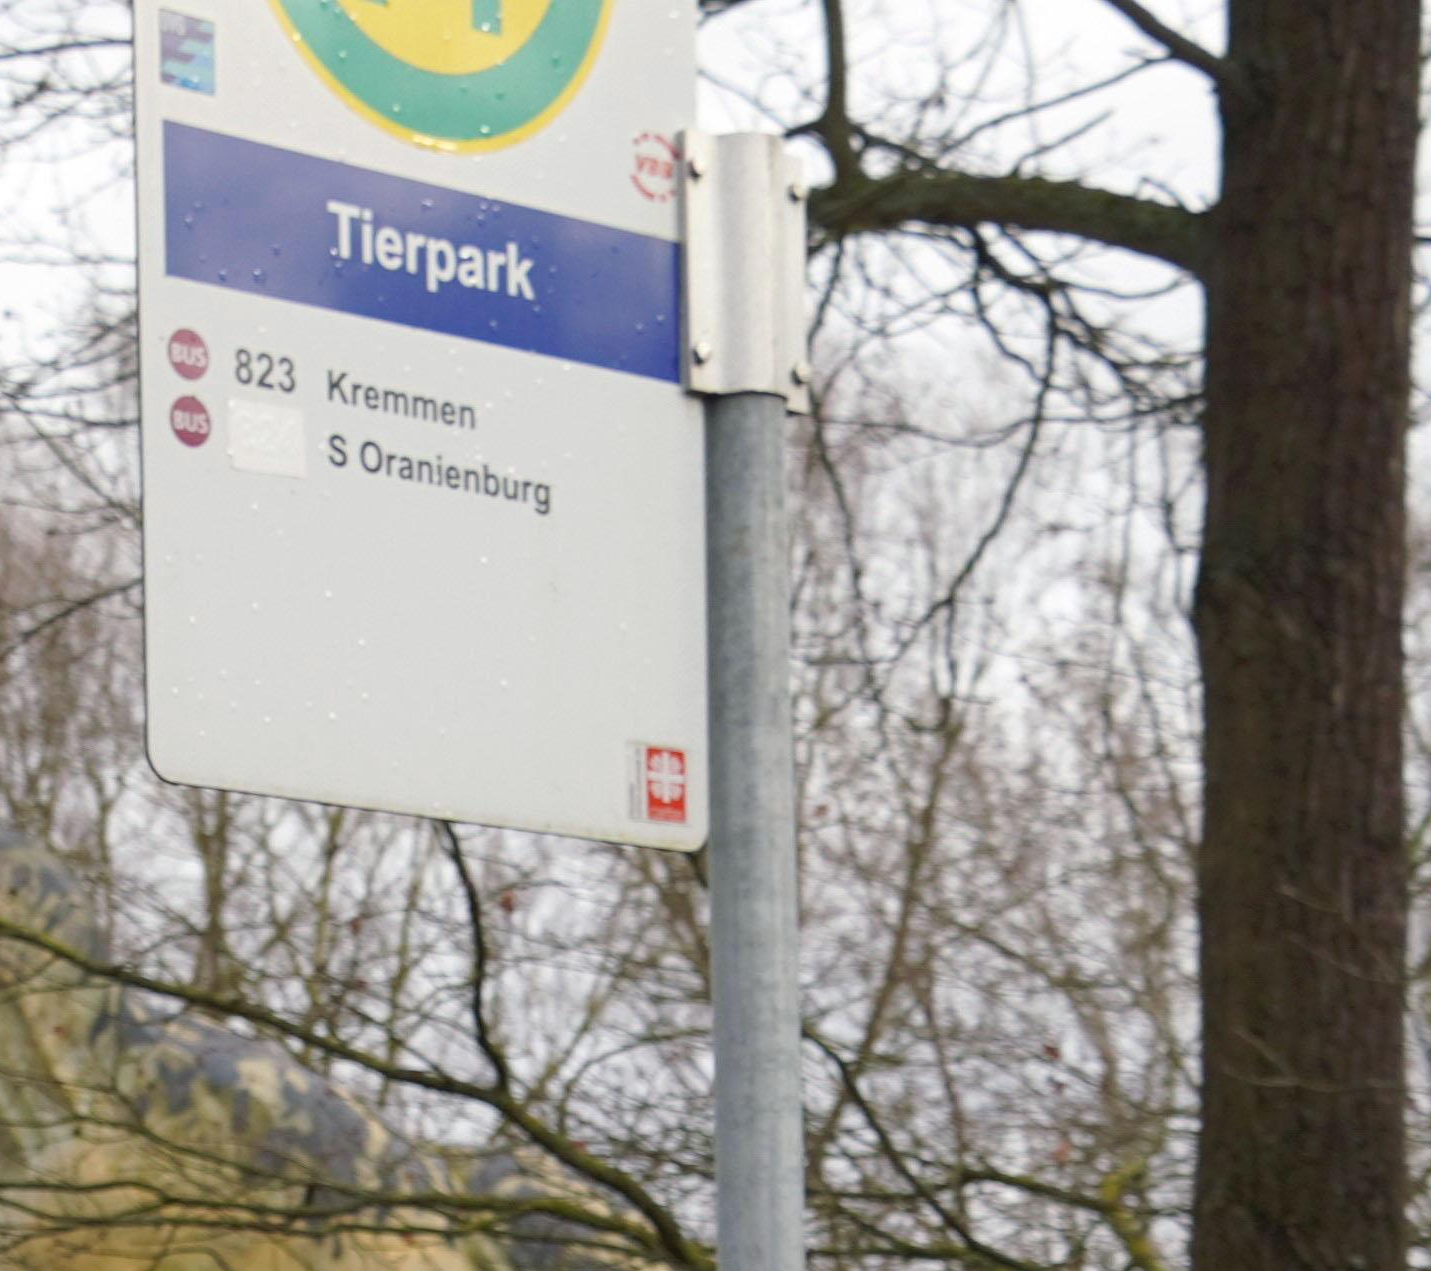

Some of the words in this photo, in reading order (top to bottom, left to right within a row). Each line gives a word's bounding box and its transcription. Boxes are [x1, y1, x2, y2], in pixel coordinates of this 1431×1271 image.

[326, 199, 536, 301] Tierpark
[169, 342, 208, 369] BUS
[235, 348, 296, 394] 823
[326, 369, 476, 430] Kremmen
[172, 409, 211, 434] BUS
[328, 434, 348, 468] S
[359, 440, 552, 516] Oranienburg
